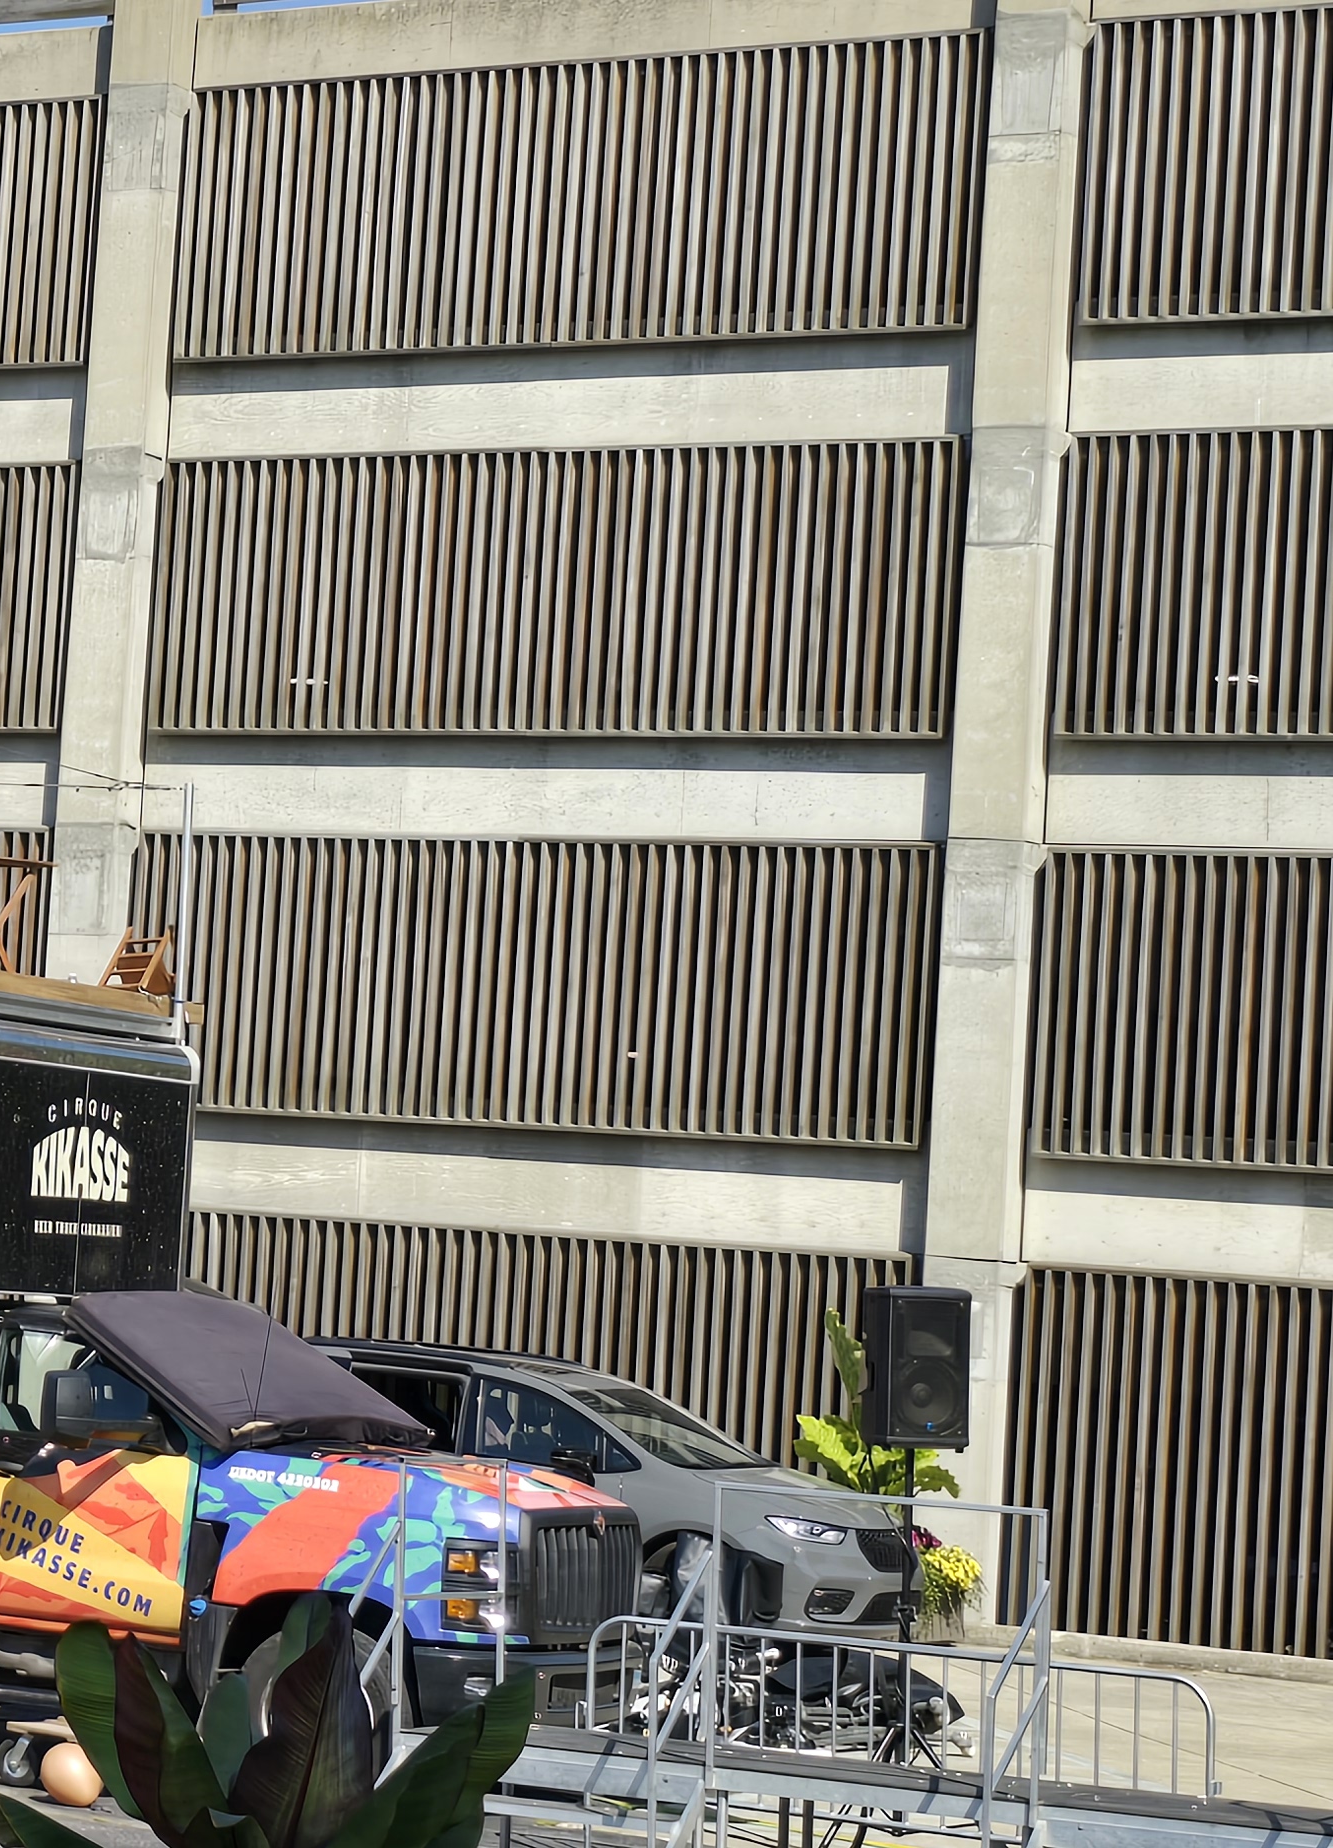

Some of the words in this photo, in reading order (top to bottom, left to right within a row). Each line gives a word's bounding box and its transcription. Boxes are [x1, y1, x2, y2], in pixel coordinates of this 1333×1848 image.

[47, 1096, 123, 1131] CIRQUE
[30, 1125, 130, 1203] KIKASSE
[0, 1499, 85, 1555] CIRQUE
